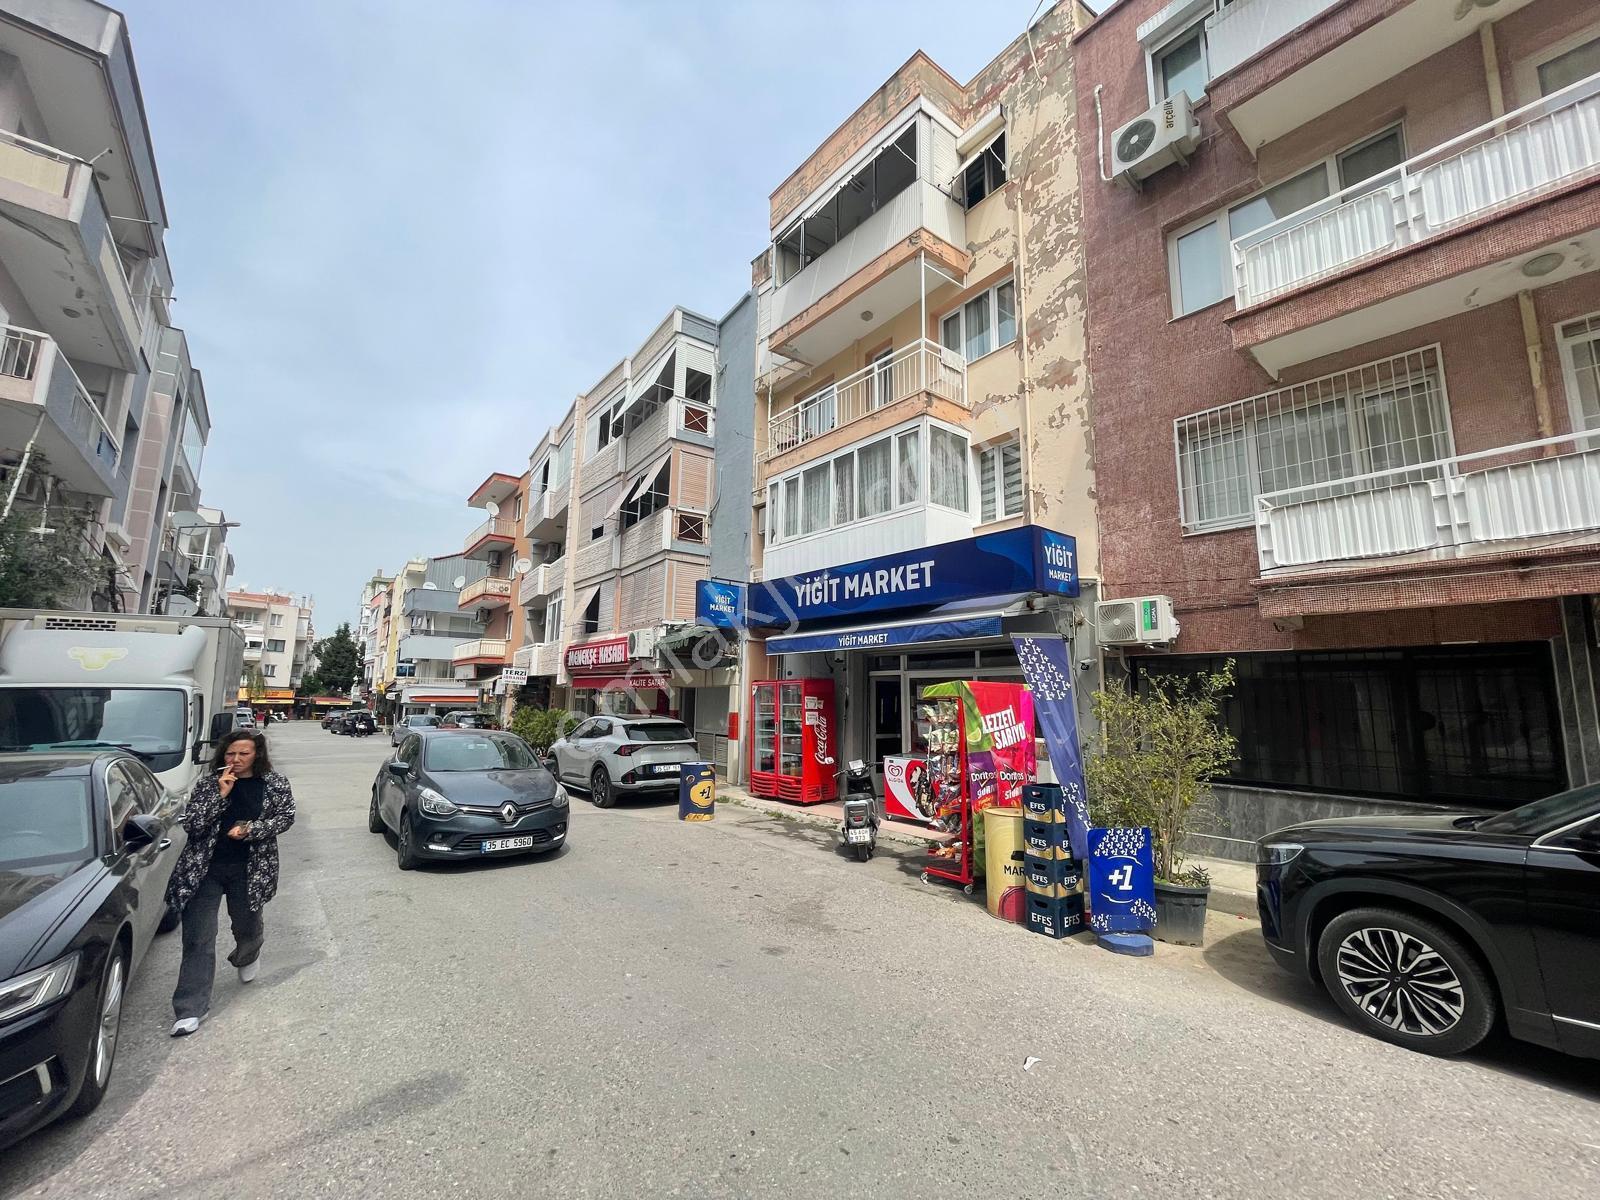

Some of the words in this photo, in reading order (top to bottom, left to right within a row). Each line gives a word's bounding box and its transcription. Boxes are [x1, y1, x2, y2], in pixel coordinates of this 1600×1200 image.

[1164, 100, 1175, 128] arçelik
[1044, 542, 1072, 568] YİĞİT
[1048, 569, 1071, 582] MARKET
[795, 574, 840, 607] YİĞİT
[844, 560, 934, 599] MARKET
[714, 594, 730, 604] YİĞİT
[710, 604, 735, 613] MARKET
[838, 635, 856, 646] YİĞİT
[858, 633, 888, 645] MARKET
[599, 644, 625, 664] KASABI
[981, 704, 1016, 734] LEZZETİ
[971, 771, 996, 782] Doritos
[1000, 771, 1024, 780] Doritos
[700, 786, 711, 799] +1
[1030, 802, 1046, 811] EFES
[487, 842, 497, 850] 35
[500, 840, 510, 848] EC
[514, 837, 532, 847] 5960
[1031, 837, 1046, 847] EFES
[1032, 873, 1048, 884] EFES
[1064, 875, 1077, 885] EFES
[1108, 865, 1133, 890] +1
[1032, 913, 1052, 926] EFES
[1064, 914, 1080, 927] EFES
